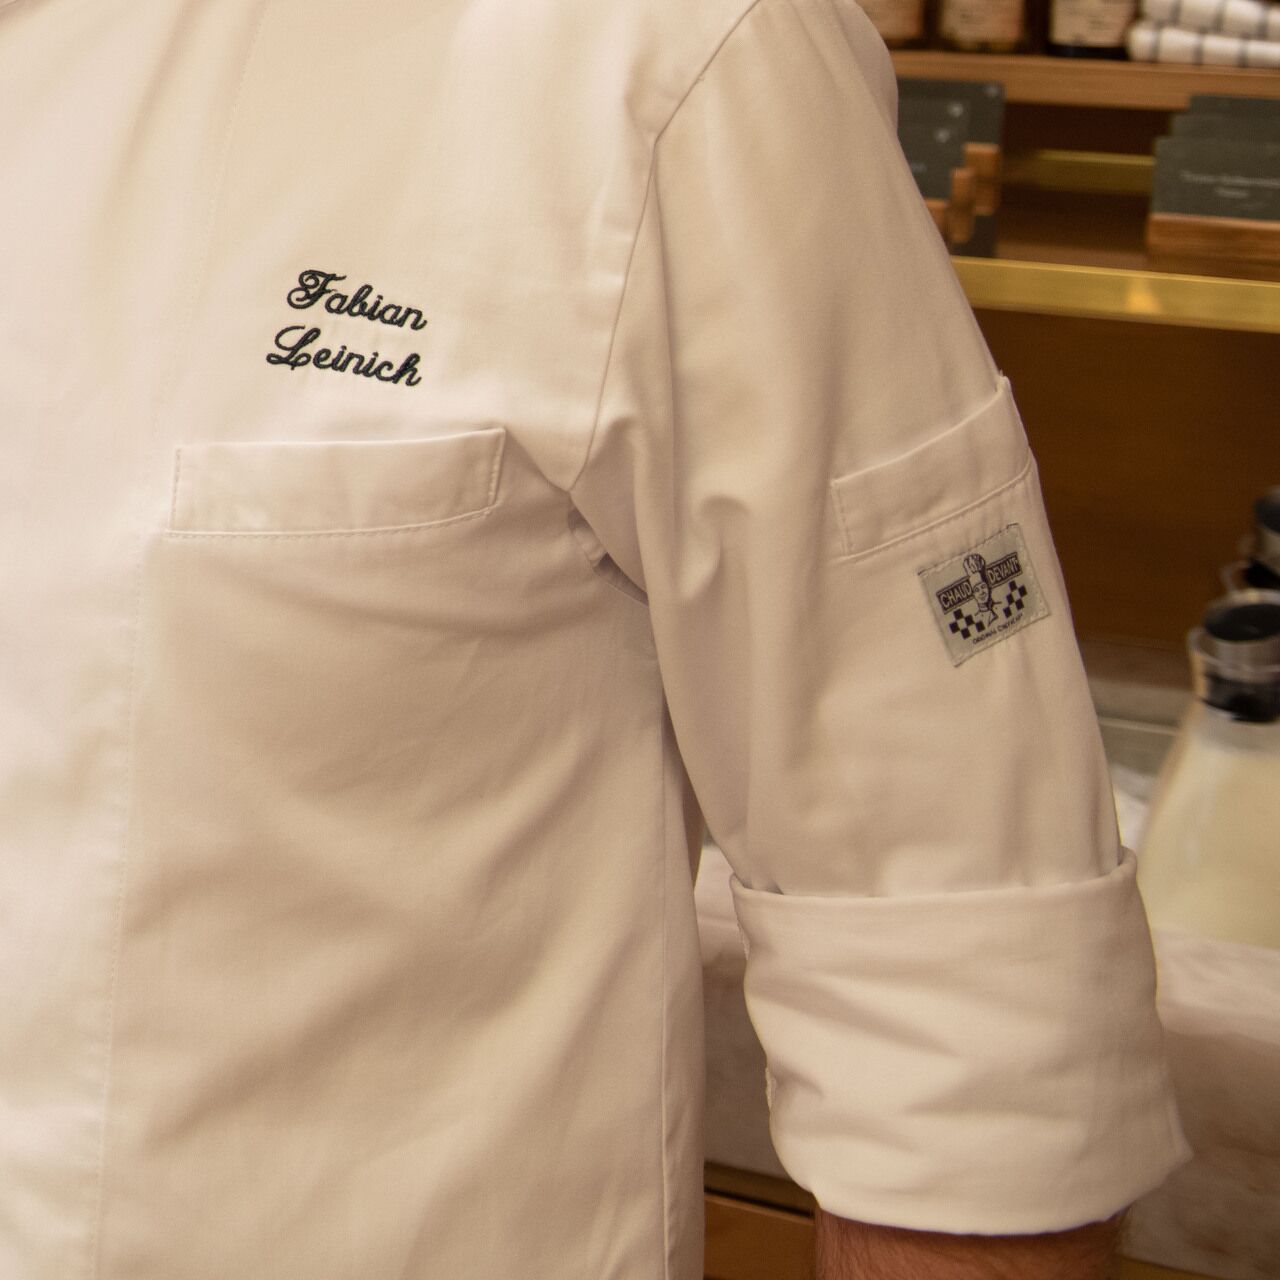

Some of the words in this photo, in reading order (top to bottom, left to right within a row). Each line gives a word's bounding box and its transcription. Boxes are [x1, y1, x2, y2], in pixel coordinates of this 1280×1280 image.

[286, 269, 428, 331] Fabian
[266, 325, 422, 387] Leinich
[939, 582, 973, 608] CHAUD
[987, 556, 1019, 584] DEVANT
